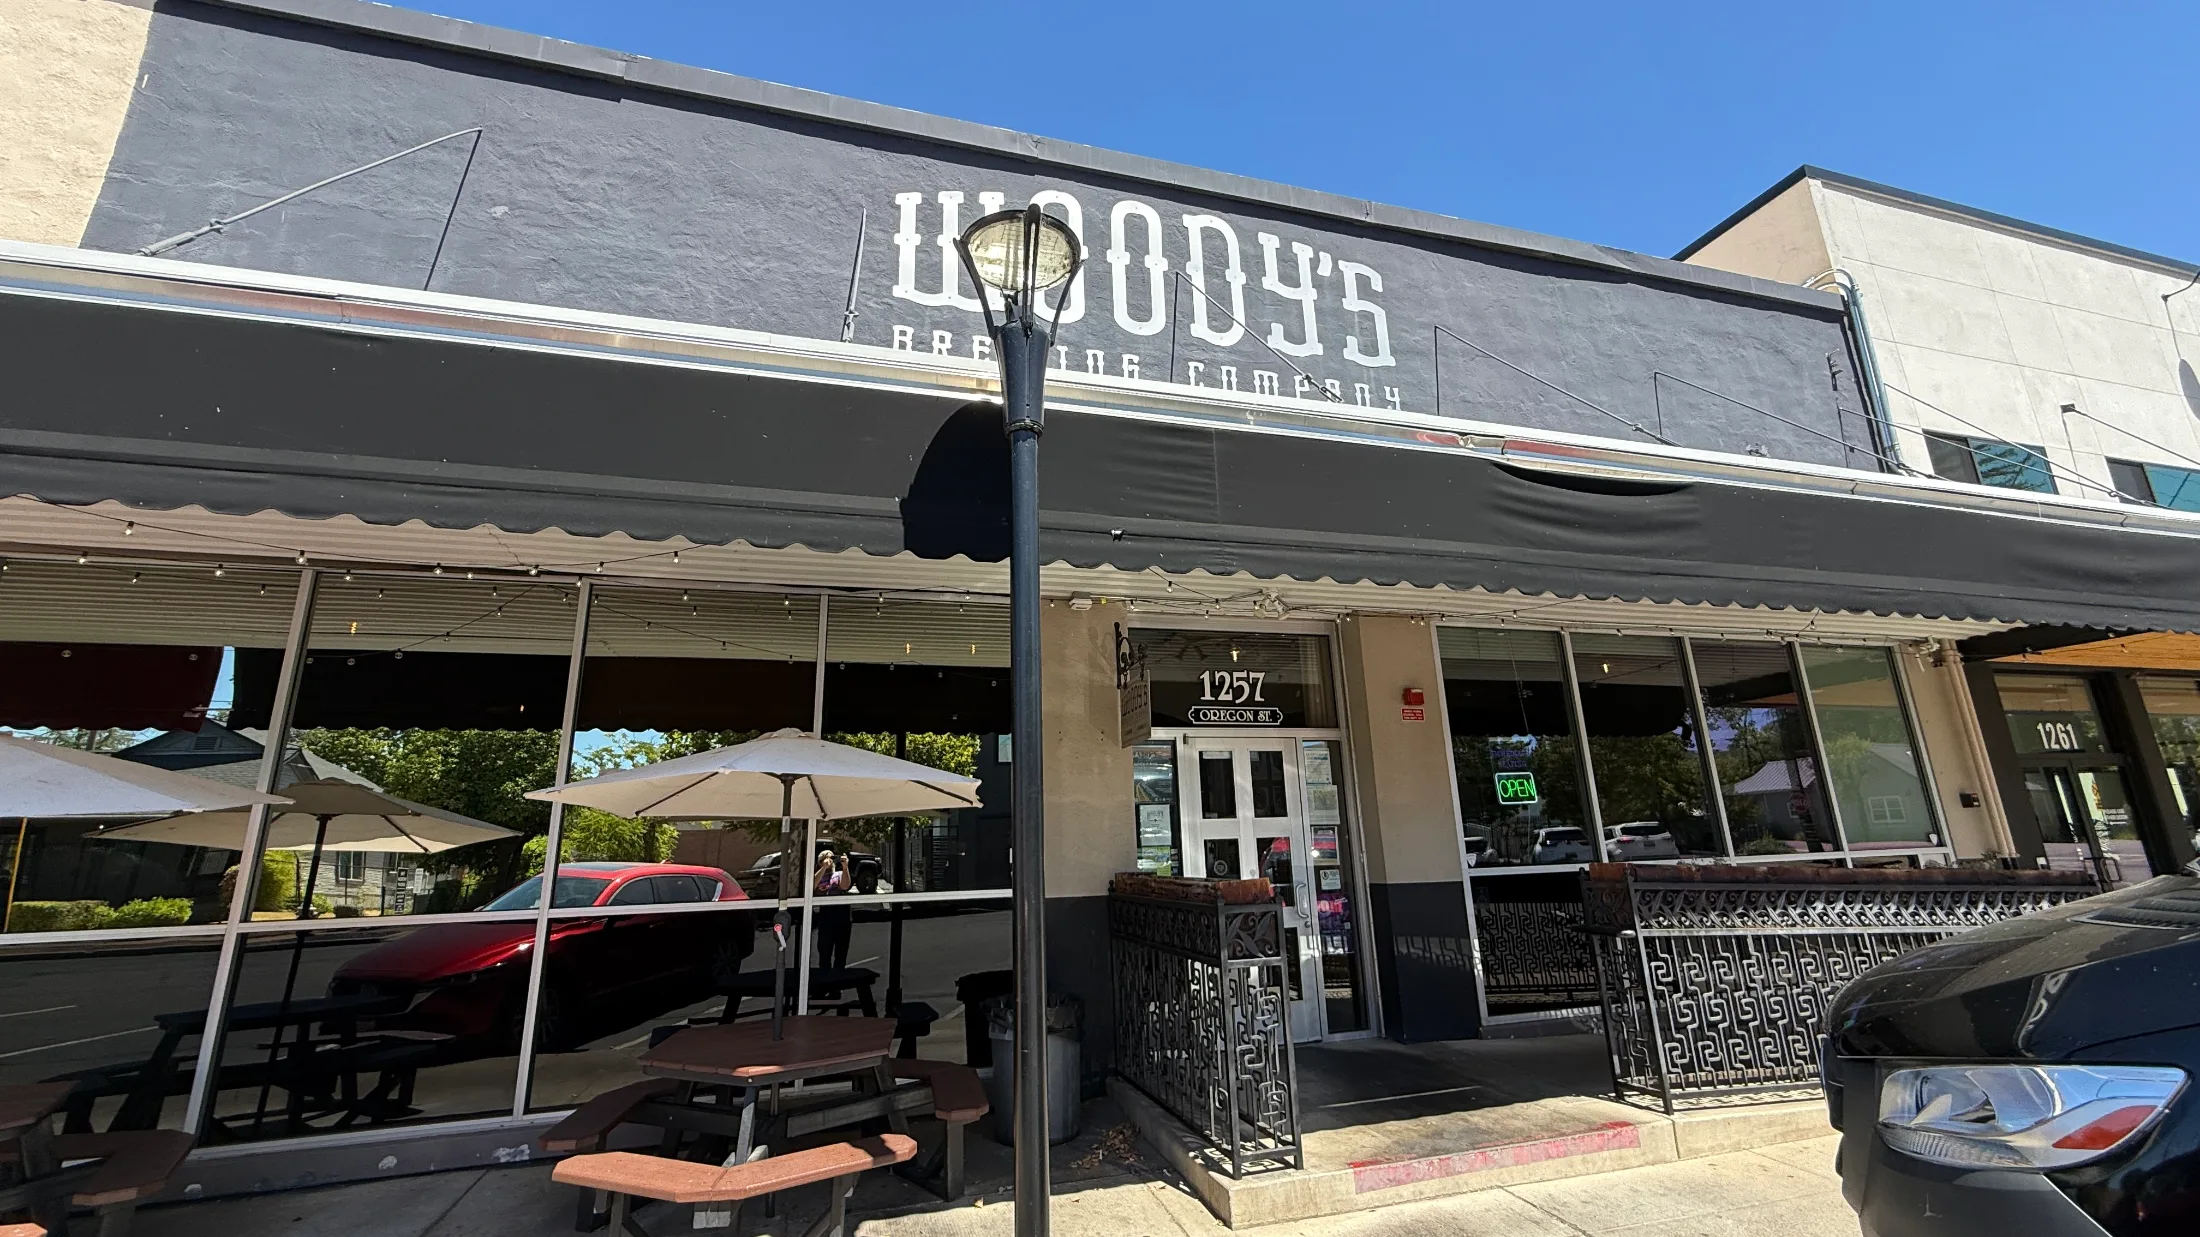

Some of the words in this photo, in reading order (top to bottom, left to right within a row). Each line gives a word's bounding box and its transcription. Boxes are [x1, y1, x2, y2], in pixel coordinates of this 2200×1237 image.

[892, 190, 1397, 367] WOODY'S
[892, 325, 1140, 380] BREING
[1199, 670, 1266, 704] 1257
[1199, 709, 1254, 722] OREGON
[1257, 710, 1273, 722] ST.
[2036, 722, 2079, 750] 1261
[1499, 779, 1535, 798] OPEN
